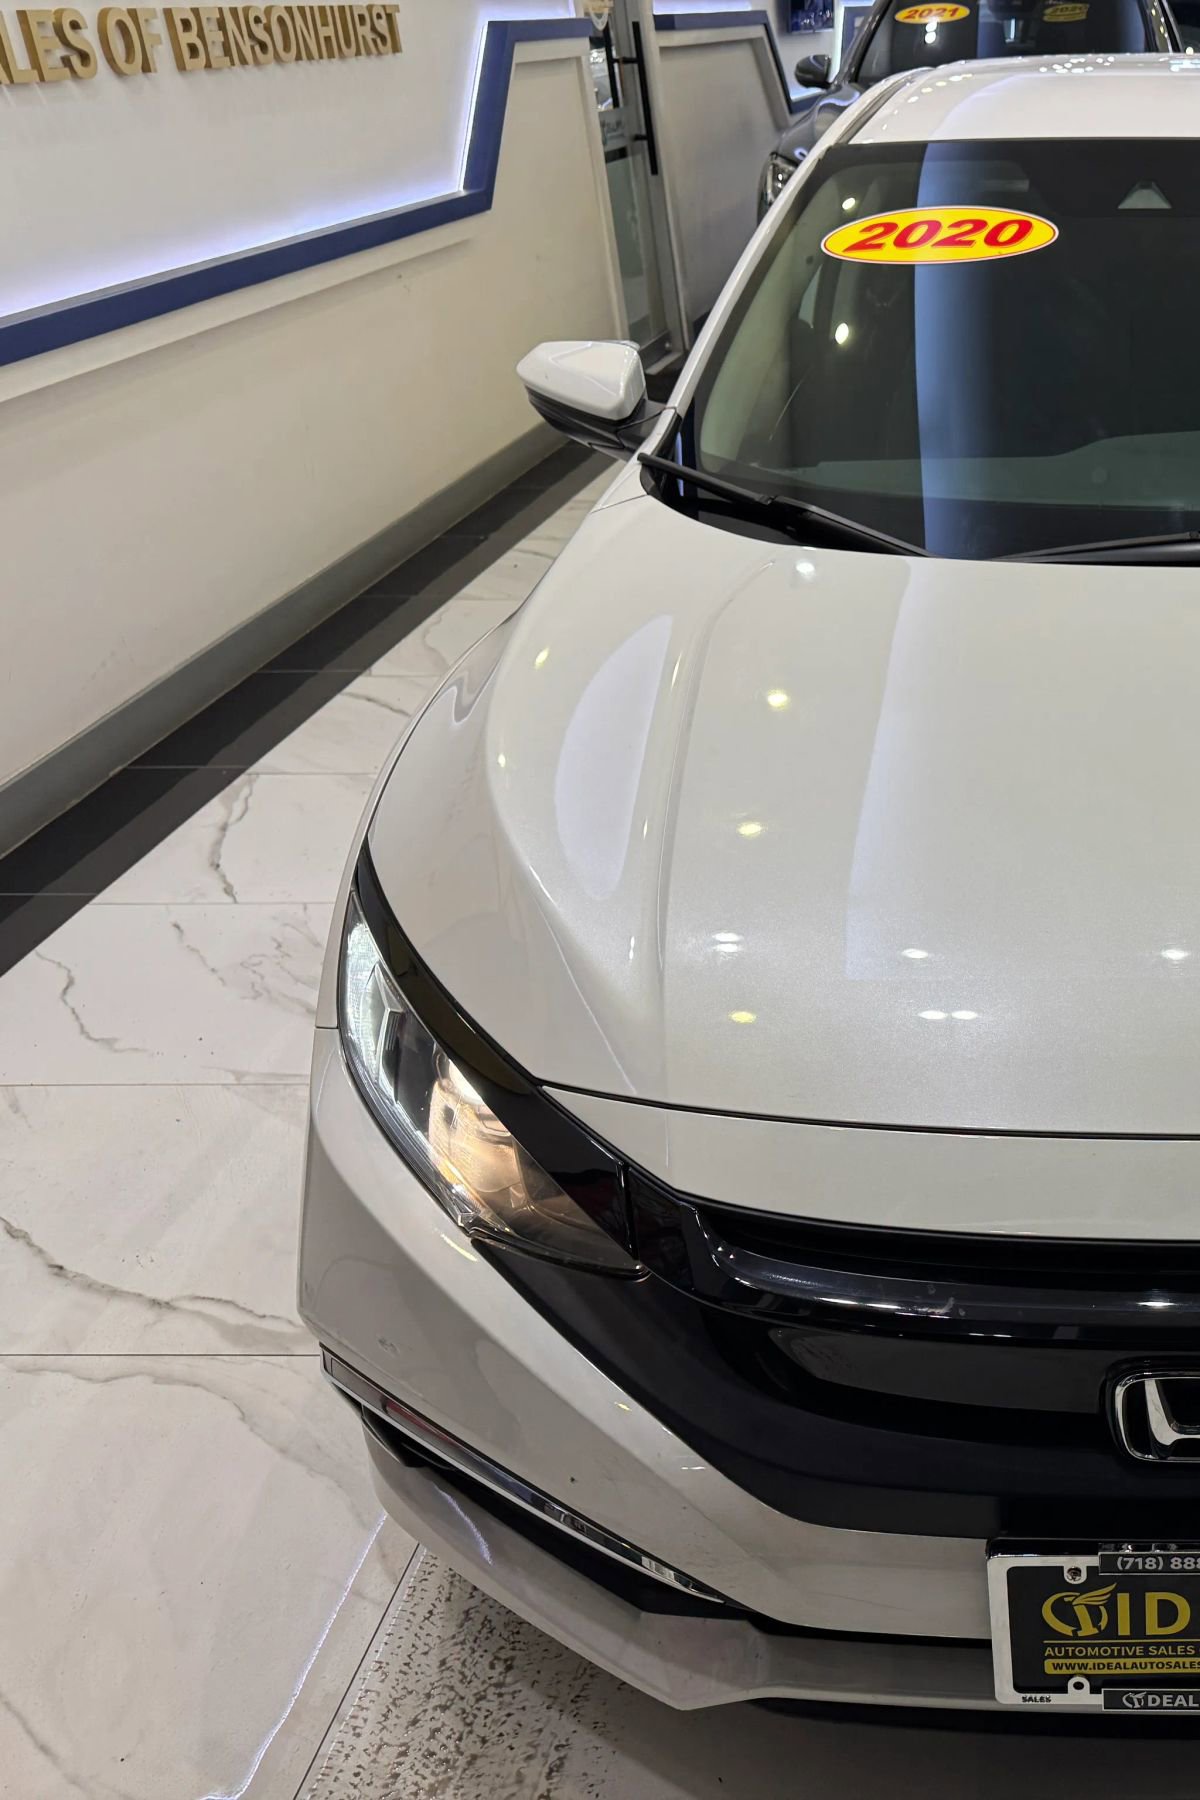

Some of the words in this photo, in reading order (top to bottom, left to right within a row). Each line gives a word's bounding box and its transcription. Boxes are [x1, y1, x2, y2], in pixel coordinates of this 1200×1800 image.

[903, 8, 960, 20] 2021
[0, 8, 98, 85] LES
[99, 7, 163, 76] OF
[164, 4, 403, 72] BENSONHURST
[842, 218, 1035, 253] 2020
[1116, 1555, 1164, 1571] (718)
[1044, 1645, 1145, 1657] AUTOMOTIVE
[1148, 1645, 1196, 1656] SALES
[1021, 1695, 1052, 1703] SALES
